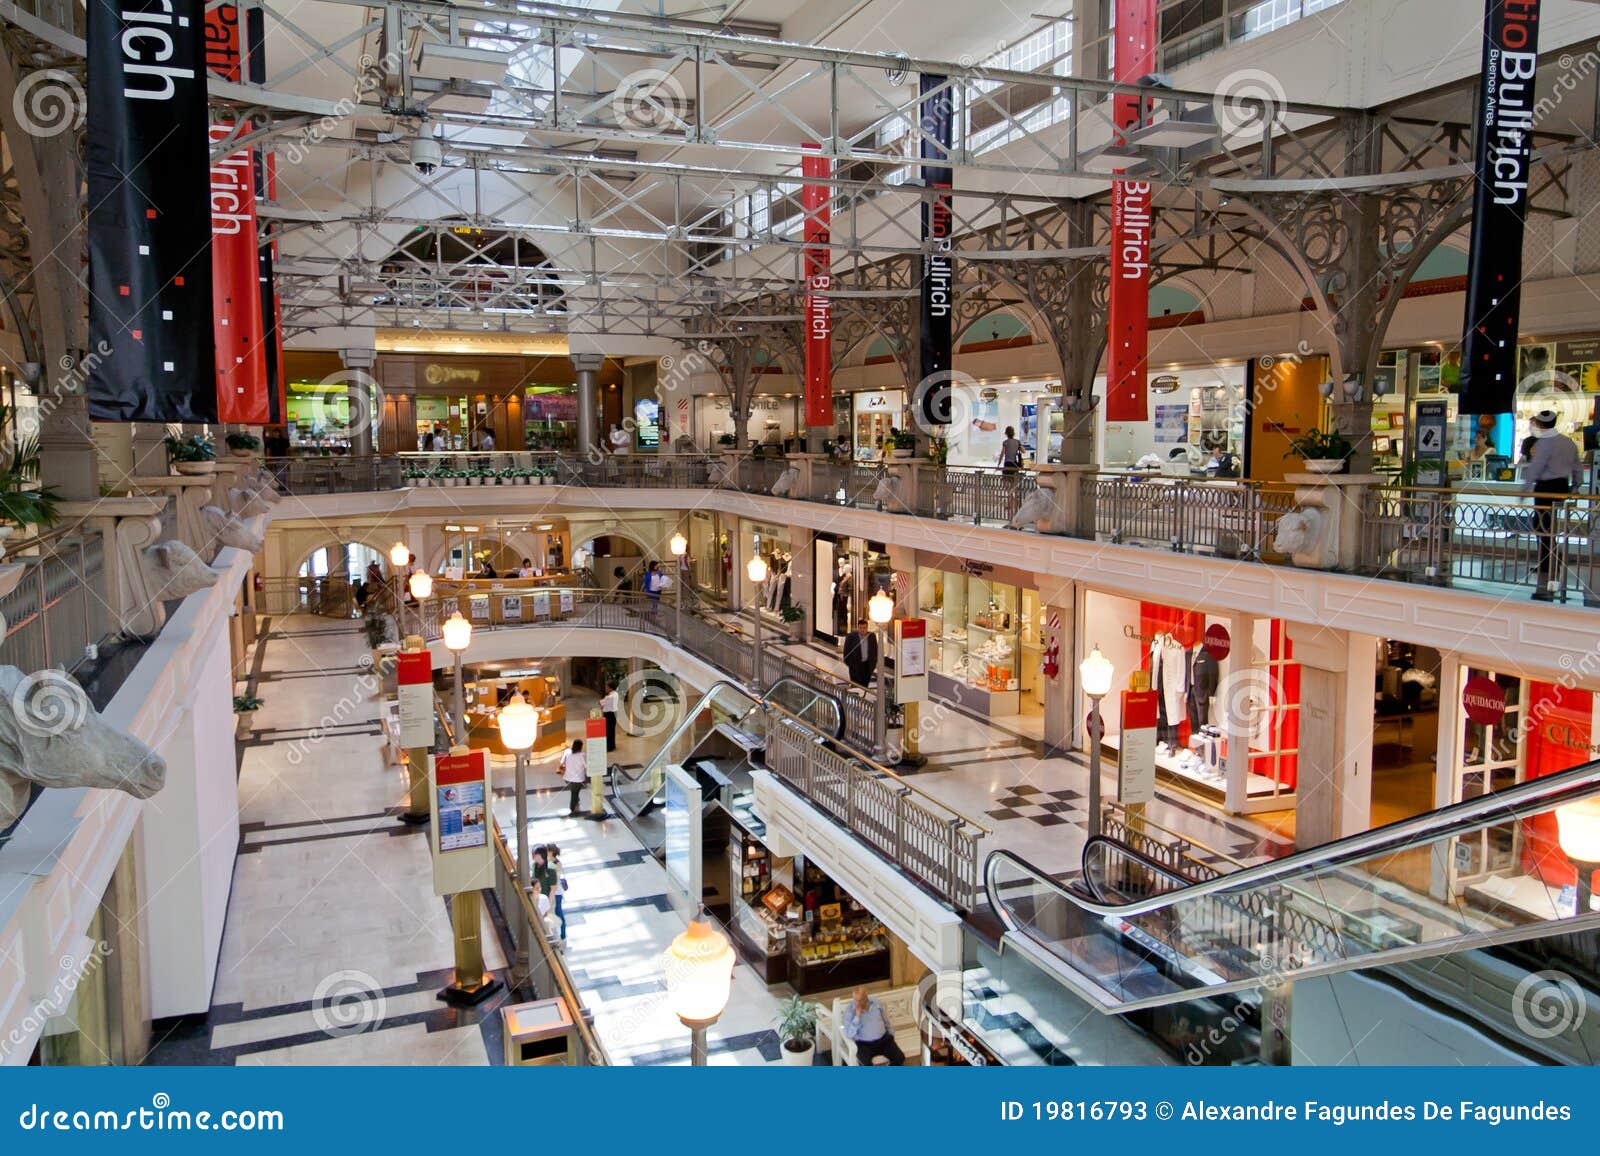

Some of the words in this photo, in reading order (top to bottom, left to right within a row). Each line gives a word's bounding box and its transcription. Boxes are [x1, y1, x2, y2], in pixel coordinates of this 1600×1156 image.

[1488, 49, 1500, 94] Buenos
[1485, 95, 1497, 127] Aires
[1493, 51, 1537, 205] Bullrich
[208, 103, 252, 235] ullrich
[812, 276, 831, 340] Bllrich
[714, 401, 780, 412] Saonite
